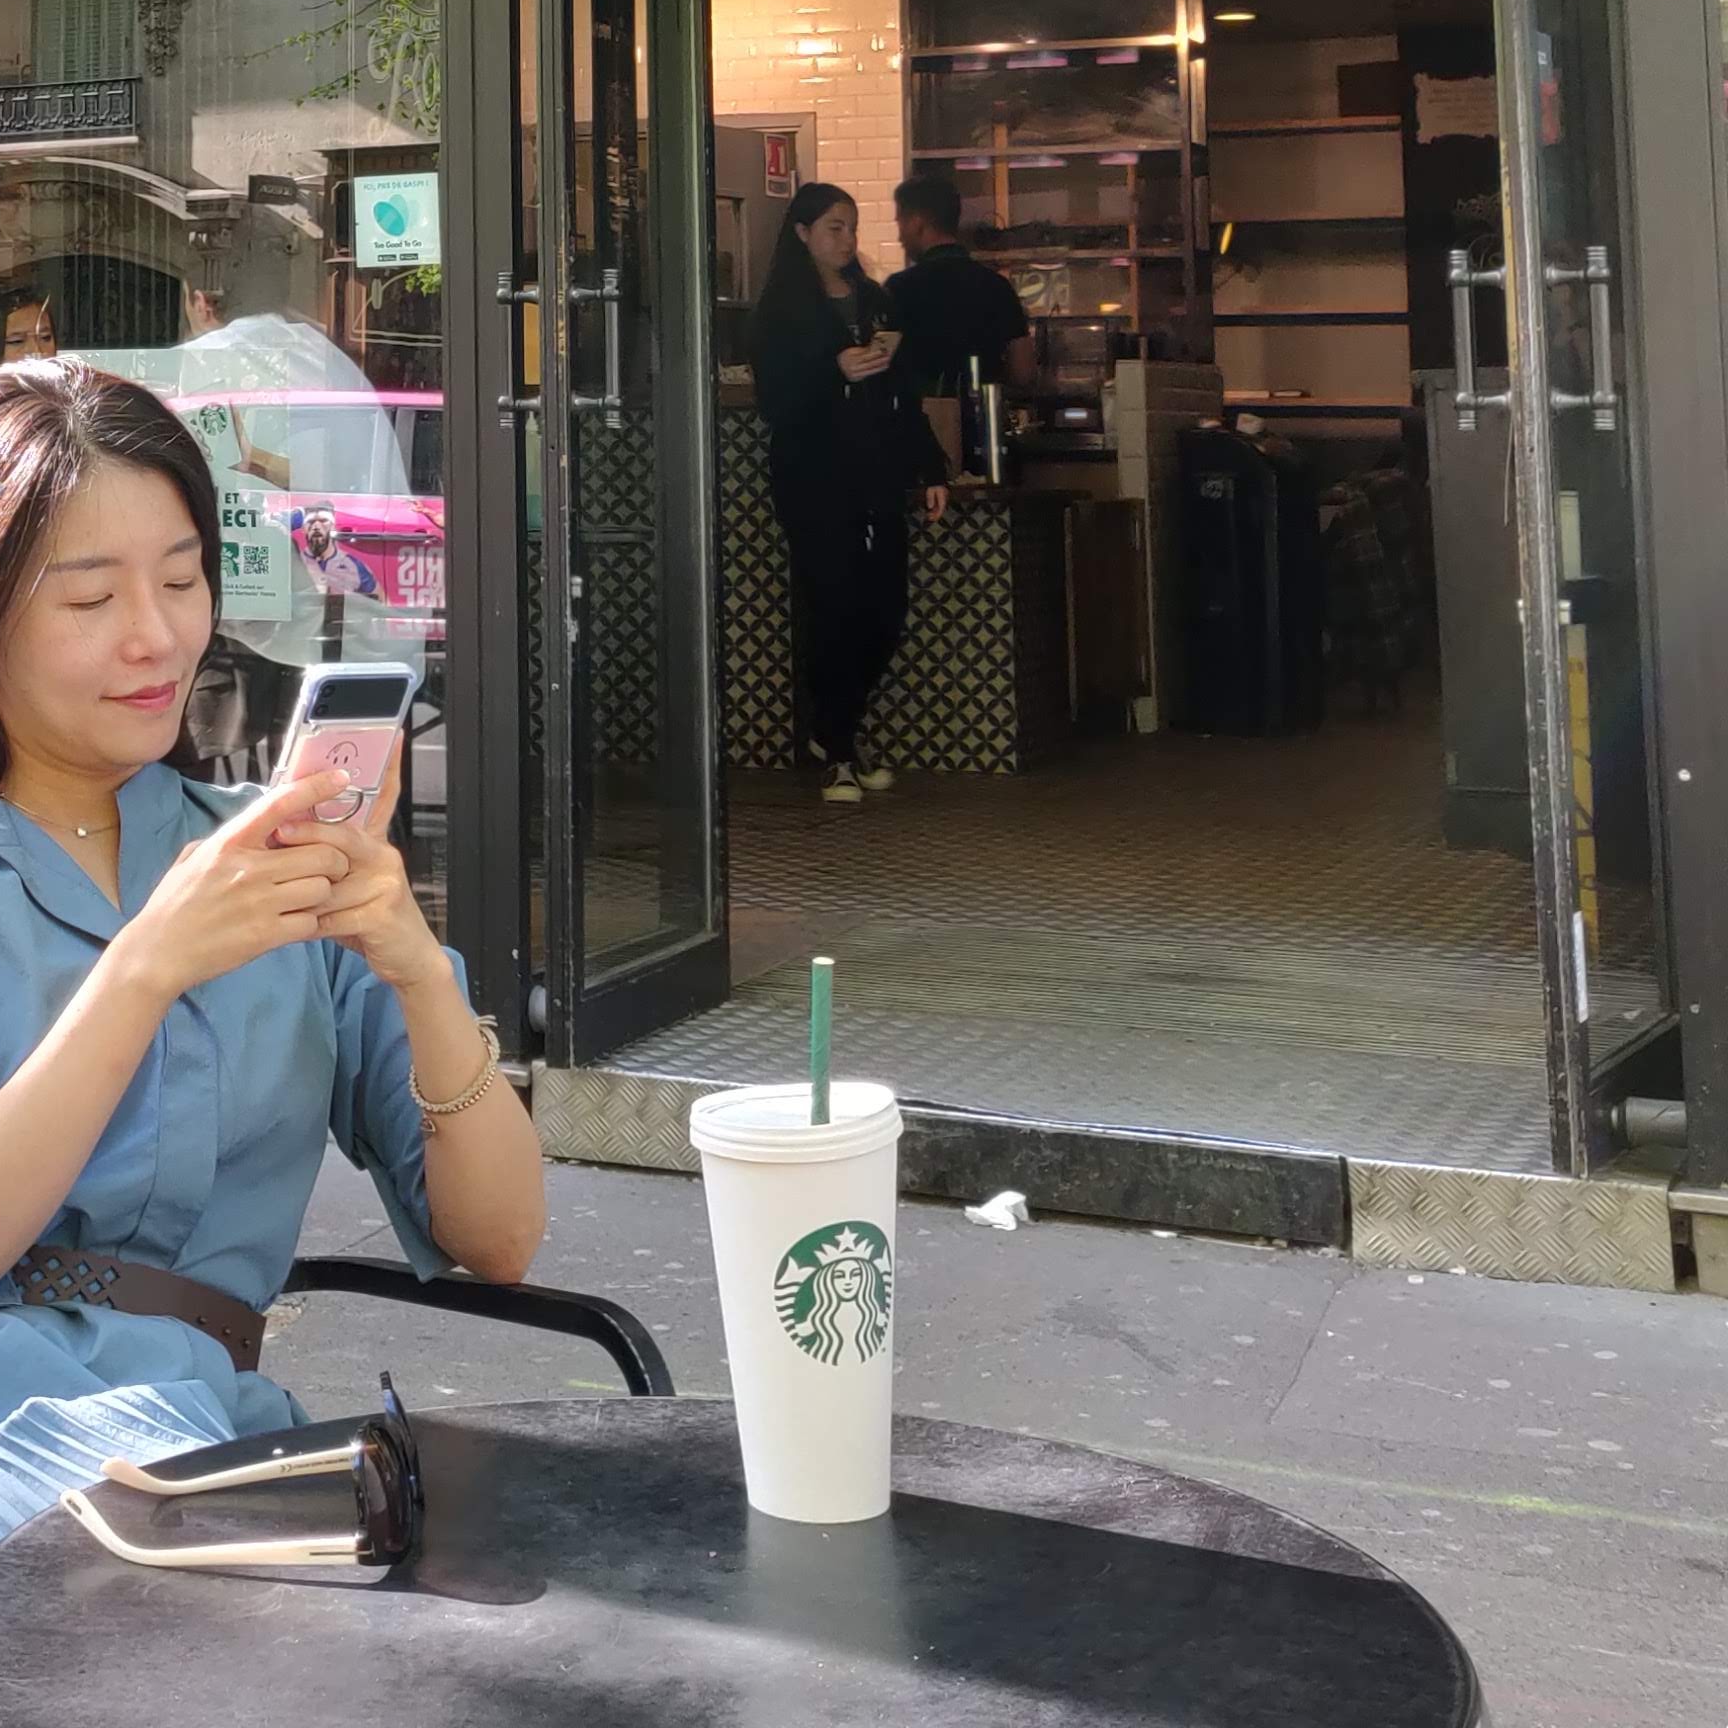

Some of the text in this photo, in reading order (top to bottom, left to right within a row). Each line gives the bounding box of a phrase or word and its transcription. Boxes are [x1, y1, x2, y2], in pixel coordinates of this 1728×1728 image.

[386, 240, 402, 248] Good
[412, 239, 422, 247] Go
[225, 493, 240, 504] ET
[223, 509, 257, 528] ECT
